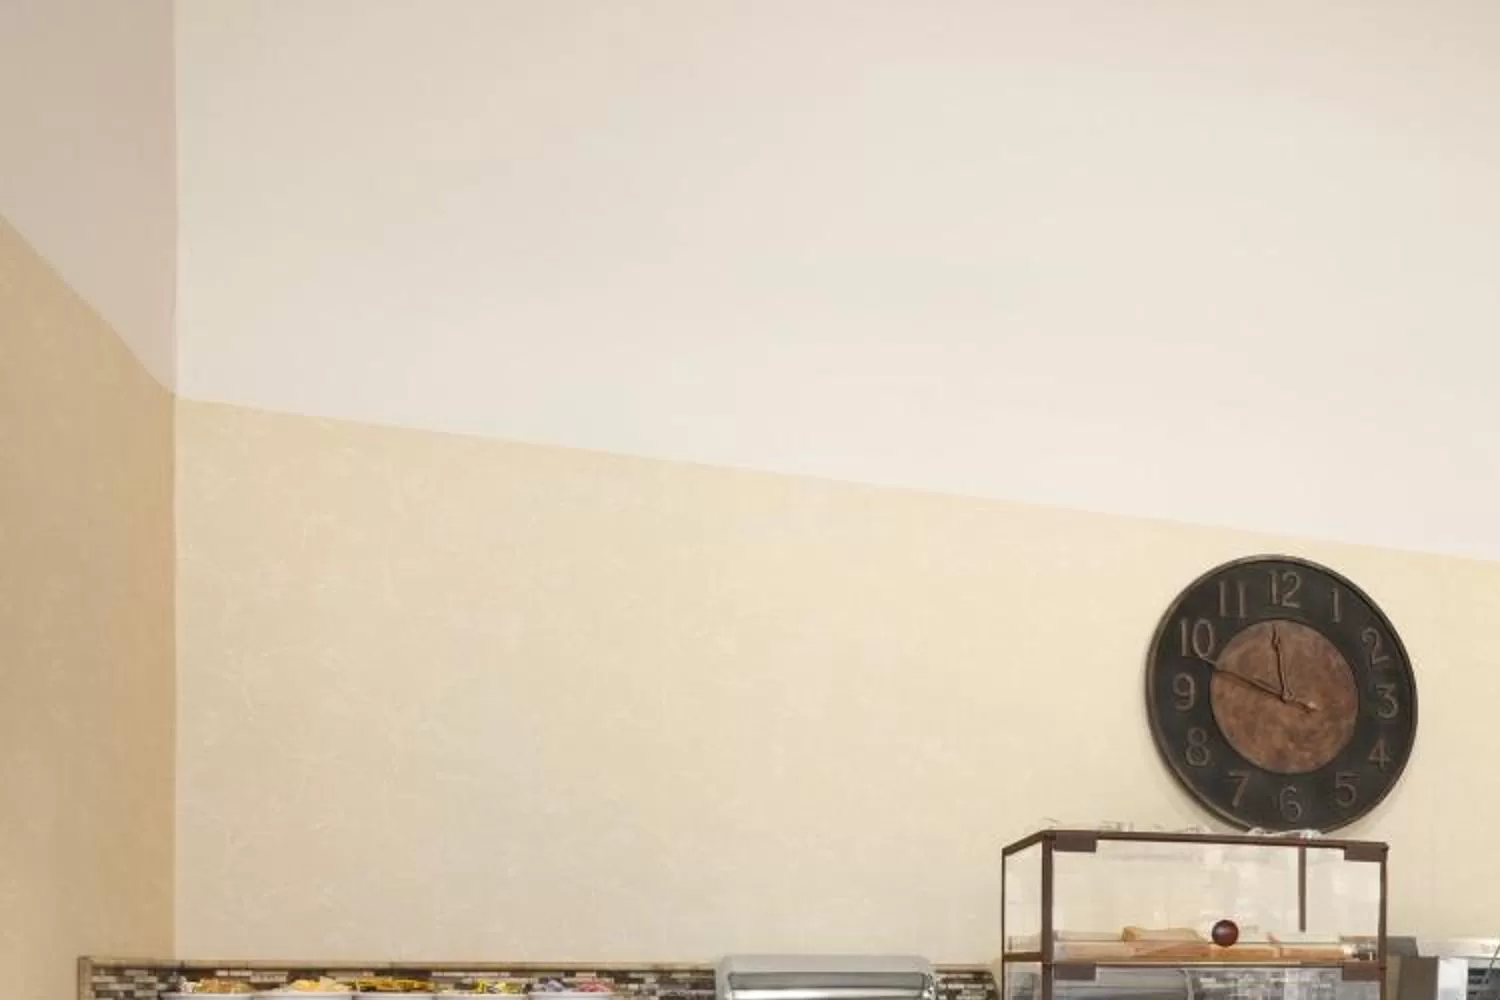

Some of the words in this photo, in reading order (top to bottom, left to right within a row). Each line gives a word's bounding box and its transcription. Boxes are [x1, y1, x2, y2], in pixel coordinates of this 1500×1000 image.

[1219, 580, 1246, 619] 11
[1269, 570, 1301, 609] 12
[1331, 587, 1342, 623] 1
[1179, 618, 1216, 658] 10
[1361, 627, 1390, 665] 2
[1172, 672, 1196, 711] 9
[1376, 683, 1398, 718] 3
[1184, 727, 1210, 767] 8
[1368, 737, 1391, 770] 4
[1225, 771, 1249, 808] 7
[1278, 785, 1303, 822] 6
[1334, 772, 1360, 807] 5
